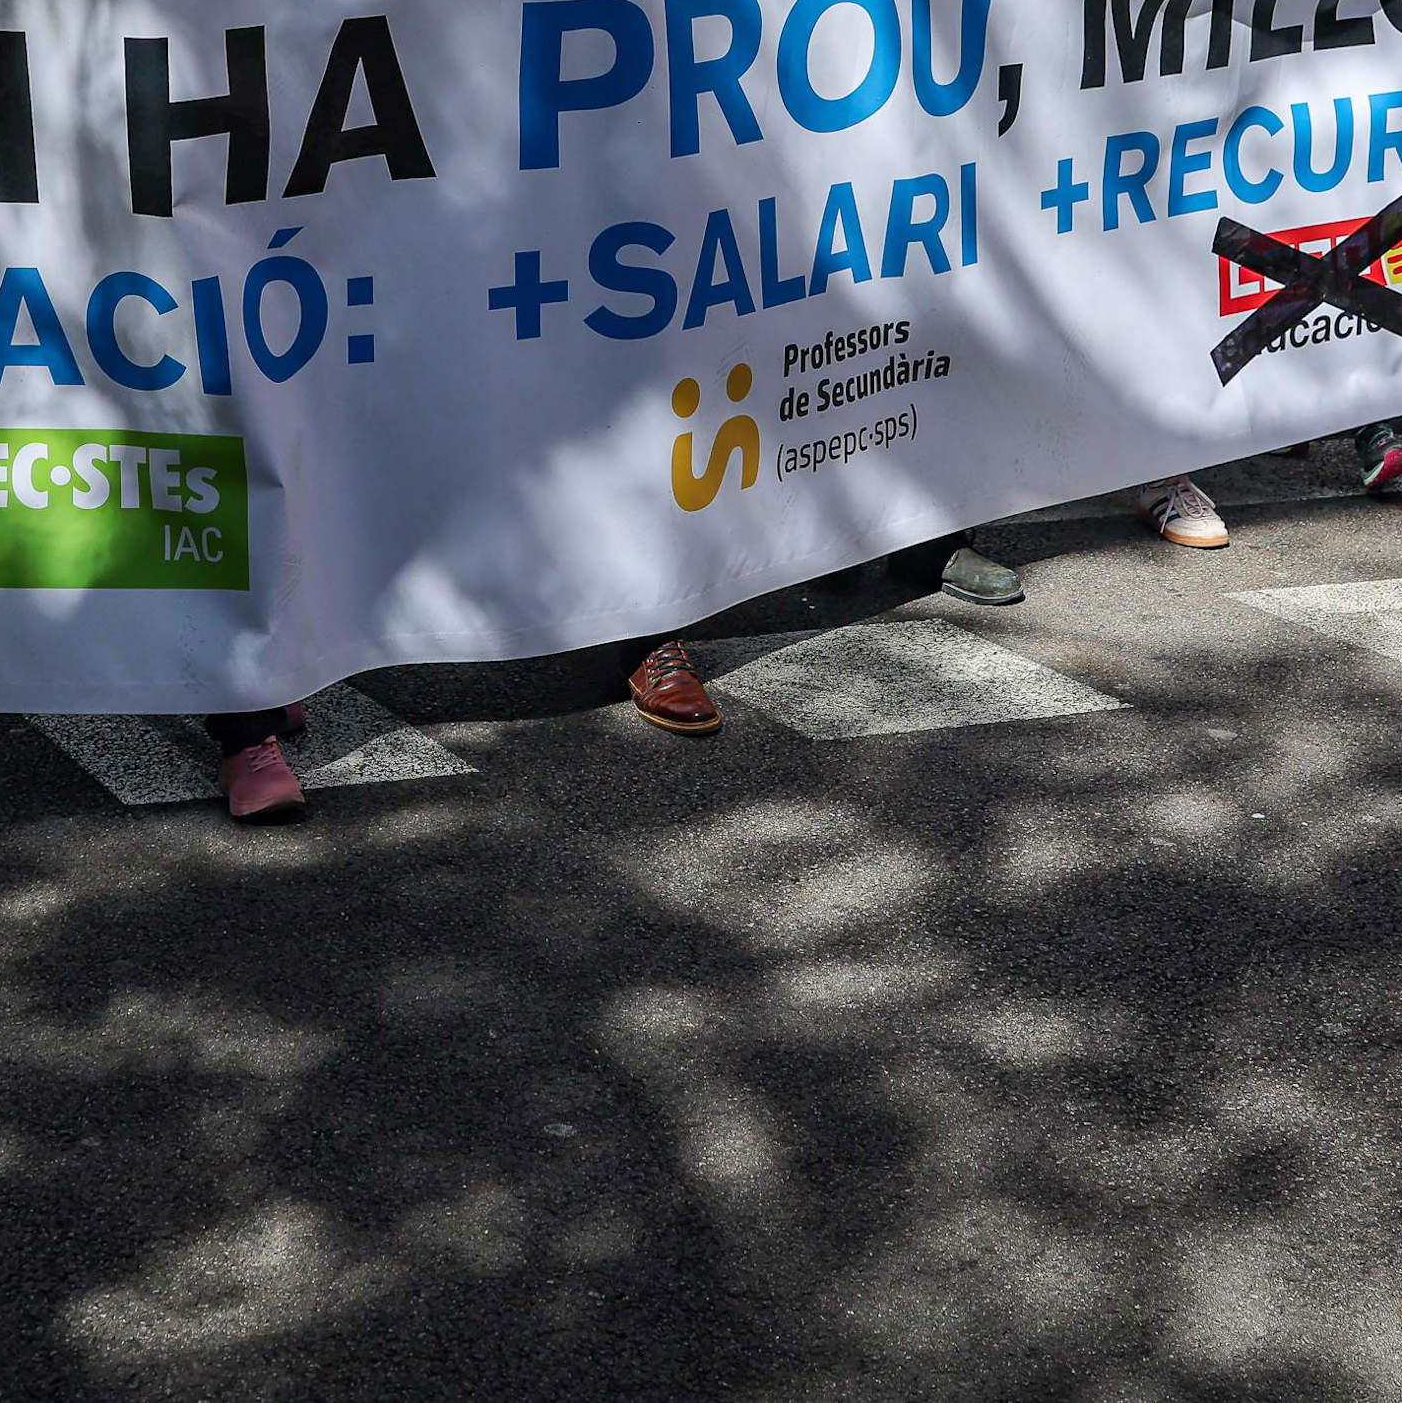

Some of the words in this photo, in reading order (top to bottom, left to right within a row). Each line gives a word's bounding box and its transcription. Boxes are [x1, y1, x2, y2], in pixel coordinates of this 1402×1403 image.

[124, 15, 436, 217] HA
[489, 162, 978, 339] +SALARI
[779, 385, 809, 422] de
[817, 349, 952, 412] Secundària
[784, 320, 911, 378] Professors
[776, 403, 919, 482] (aspepc·sps)
[164, 525, 224, 563] IAC
